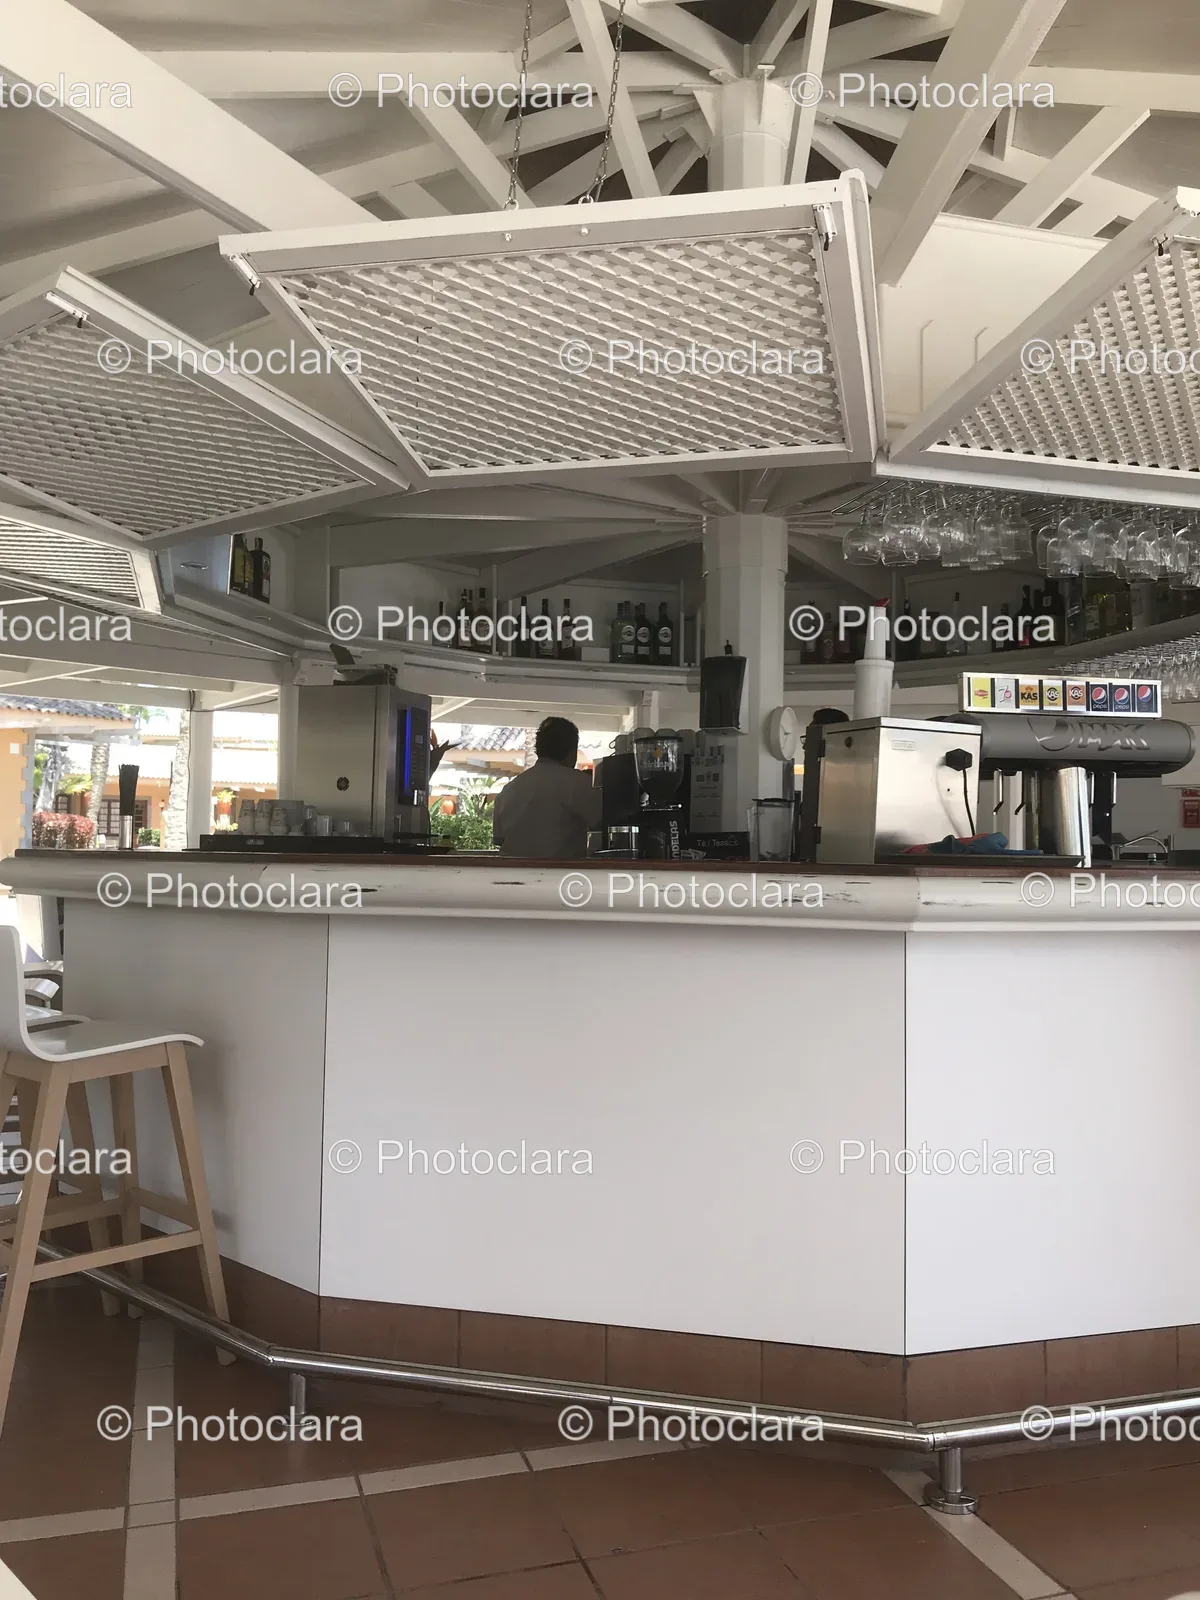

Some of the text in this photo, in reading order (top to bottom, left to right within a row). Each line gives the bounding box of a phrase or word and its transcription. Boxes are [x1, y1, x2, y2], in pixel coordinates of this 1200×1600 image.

[1020, 692, 1038, 701] KAS
[1046, 690, 1059, 698] KAS
[1069, 689, 1083, 697] KAS
[669, 820, 680, 860] NDELAS
